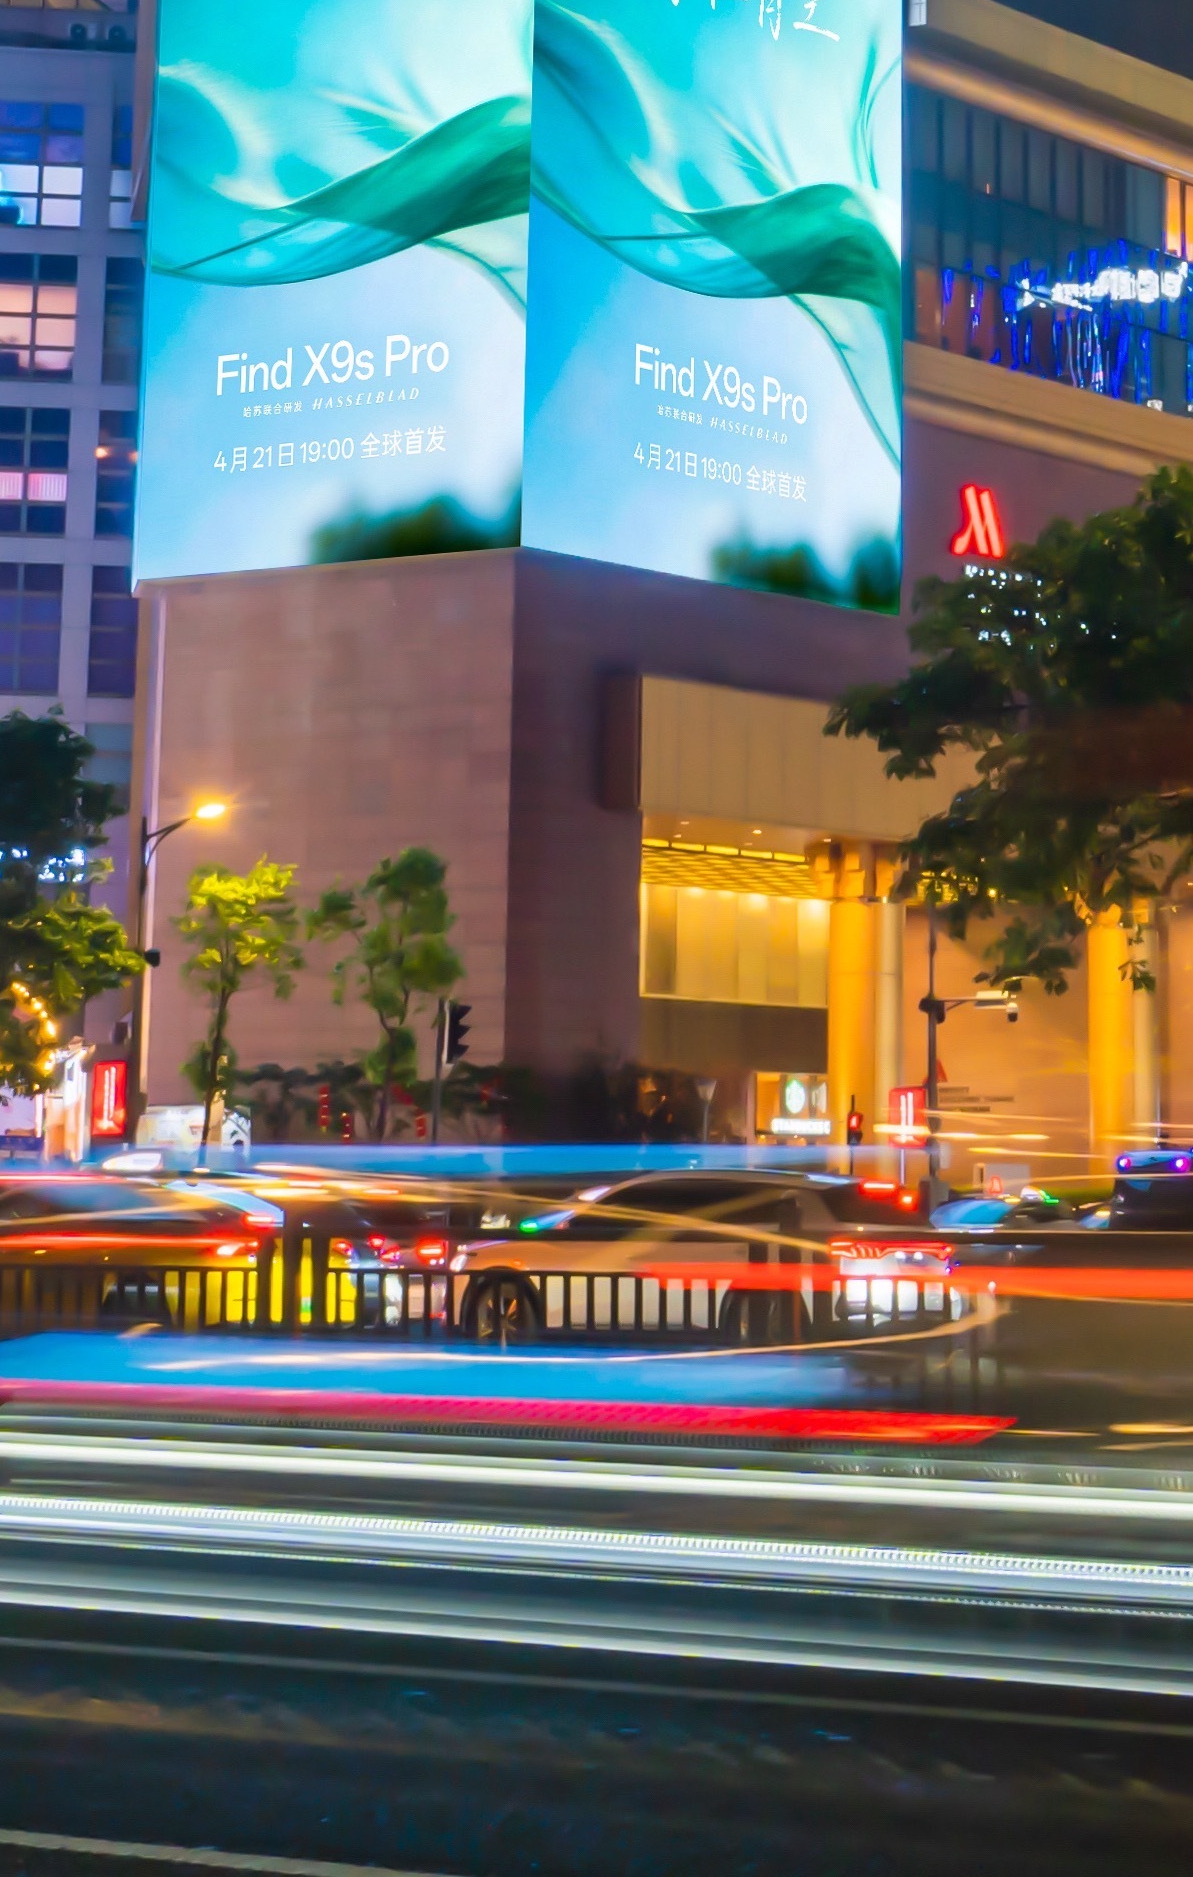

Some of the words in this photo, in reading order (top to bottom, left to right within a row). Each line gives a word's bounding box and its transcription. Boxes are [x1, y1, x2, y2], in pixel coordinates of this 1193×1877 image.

[216, 347, 293, 396] Find
[302, 340, 375, 384] X9s
[385, 334, 450, 376] Pro
[635, 343, 695, 398] Find
[702, 360, 756, 413] X9s
[763, 375, 808, 425] Pro
[243, 401, 303, 418] 哈苏联合研发
[312, 387, 420, 410] HASSELBLAD
[360, 425, 447, 459] 全球首发
[710, 416, 788, 444] HASSELBLAD
[746, 465, 807, 502] 全球首发
